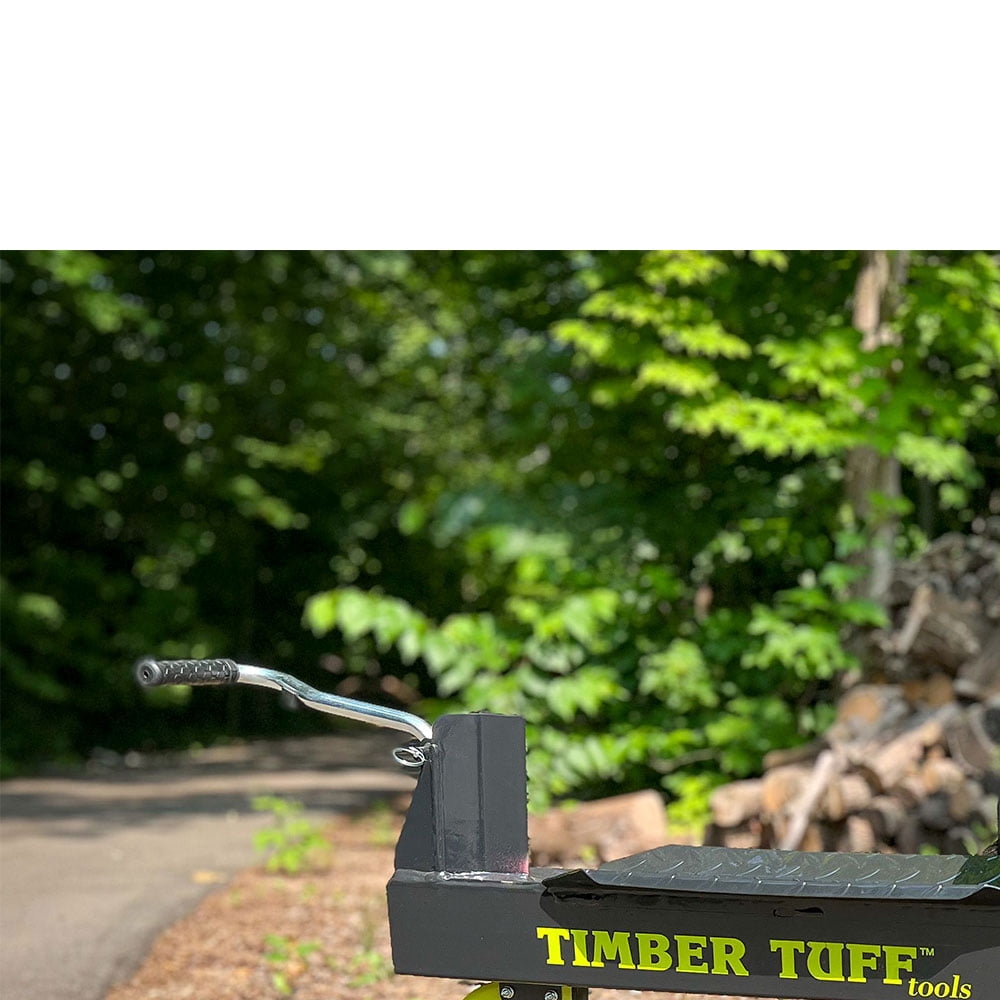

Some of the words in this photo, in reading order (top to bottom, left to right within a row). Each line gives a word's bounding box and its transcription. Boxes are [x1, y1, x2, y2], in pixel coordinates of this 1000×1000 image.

[536, 926, 750, 977] TIMBER
[769, 939, 918, 985] TUFF
[907, 974, 973, 999] tools
